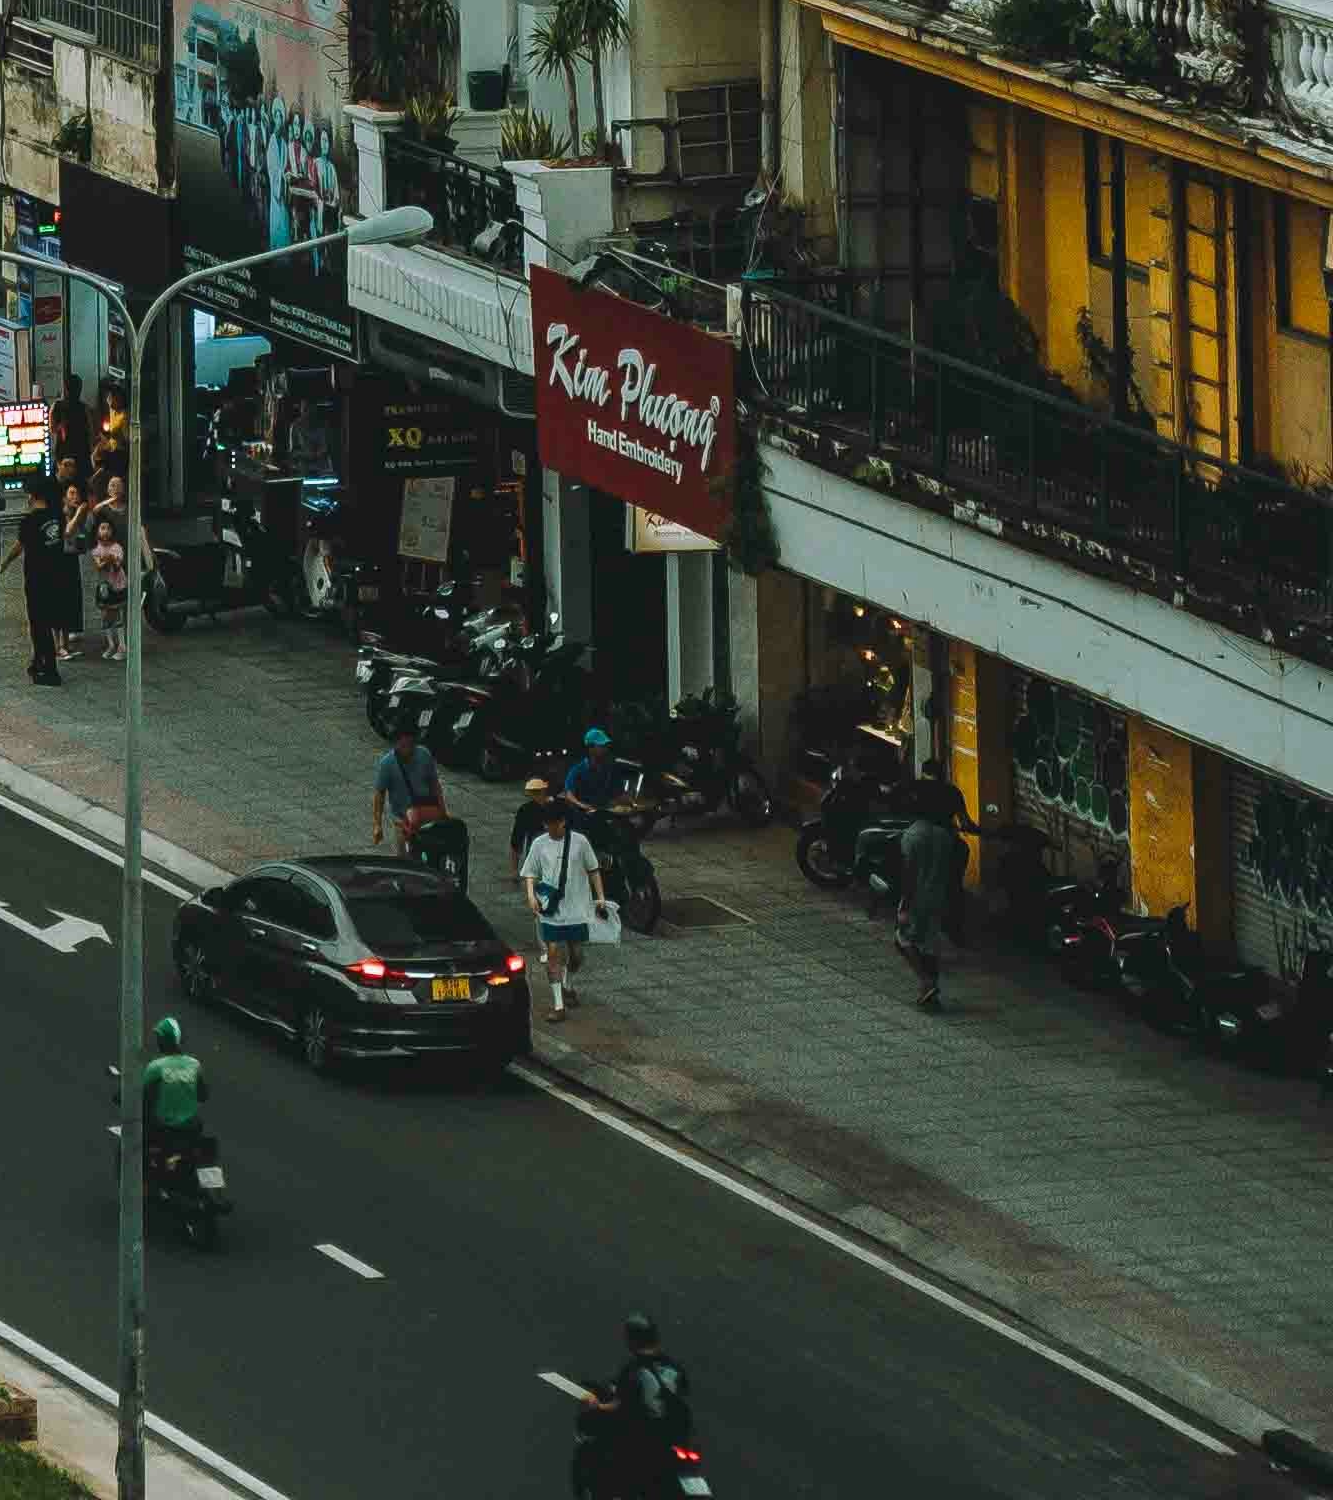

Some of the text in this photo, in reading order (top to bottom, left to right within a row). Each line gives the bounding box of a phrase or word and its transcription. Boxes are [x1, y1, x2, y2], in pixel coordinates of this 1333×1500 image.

[546, 322, 612, 407] Kim
[588, 419, 684, 485] Hand Embroidery
